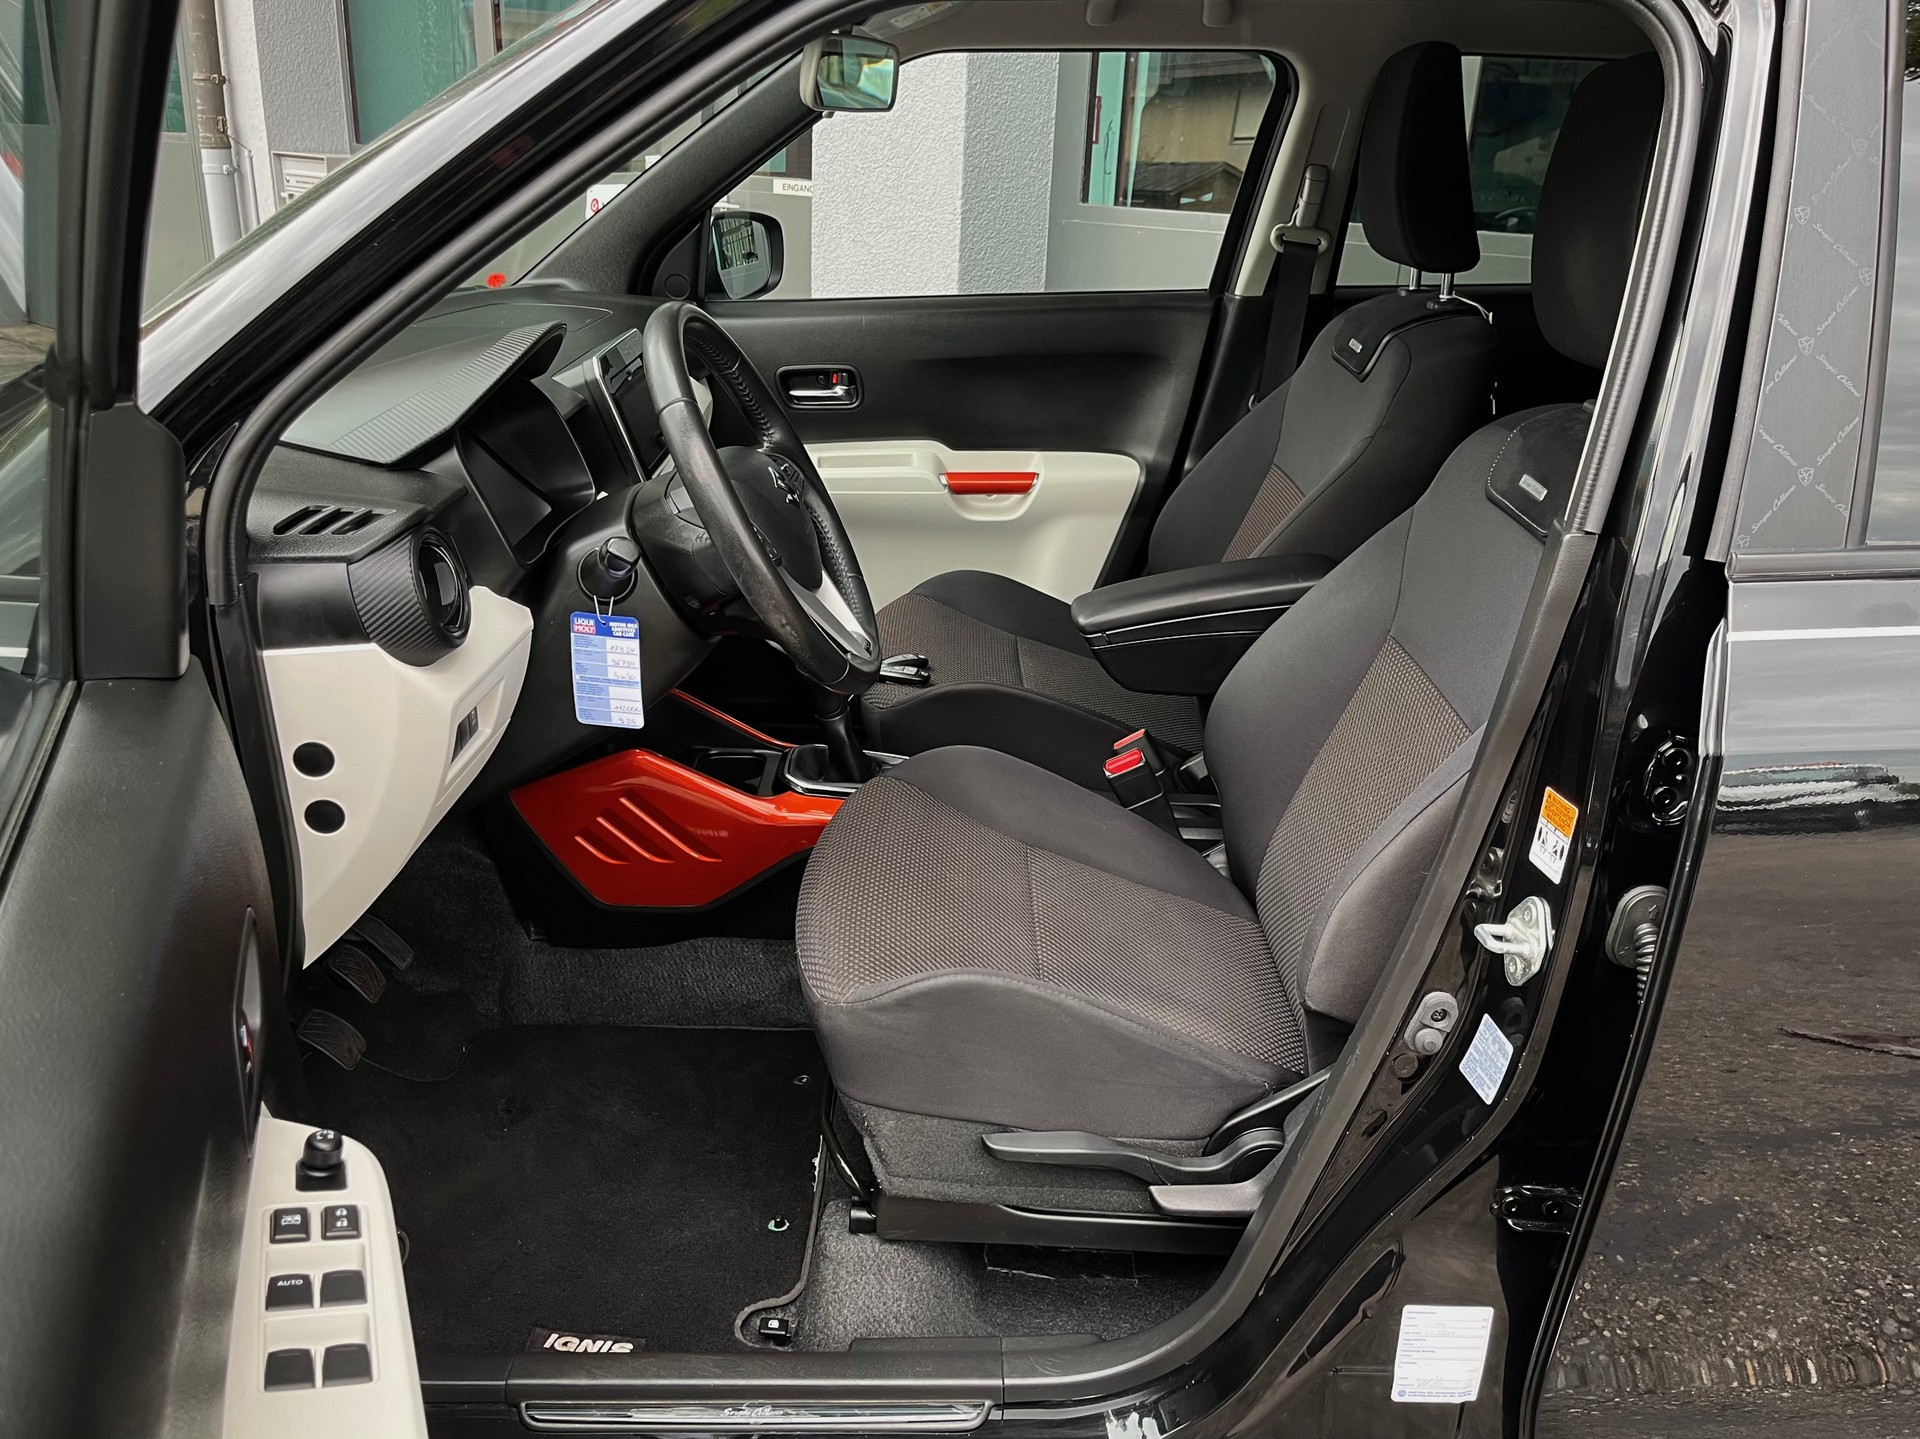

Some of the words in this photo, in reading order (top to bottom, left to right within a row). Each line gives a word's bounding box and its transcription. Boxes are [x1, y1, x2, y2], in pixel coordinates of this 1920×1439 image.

[1836, 374, 1860, 397] Cellano
[1773, 444, 1797, 466] Cellano
[574, 617, 594, 626] LIQUI
[574, 625, 596, 634] MOLY
[277, 1279, 304, 1287] AUTO
[543, 1333, 634, 1353] IGNIS
[720, 1407, 751, 1417] Sergio
